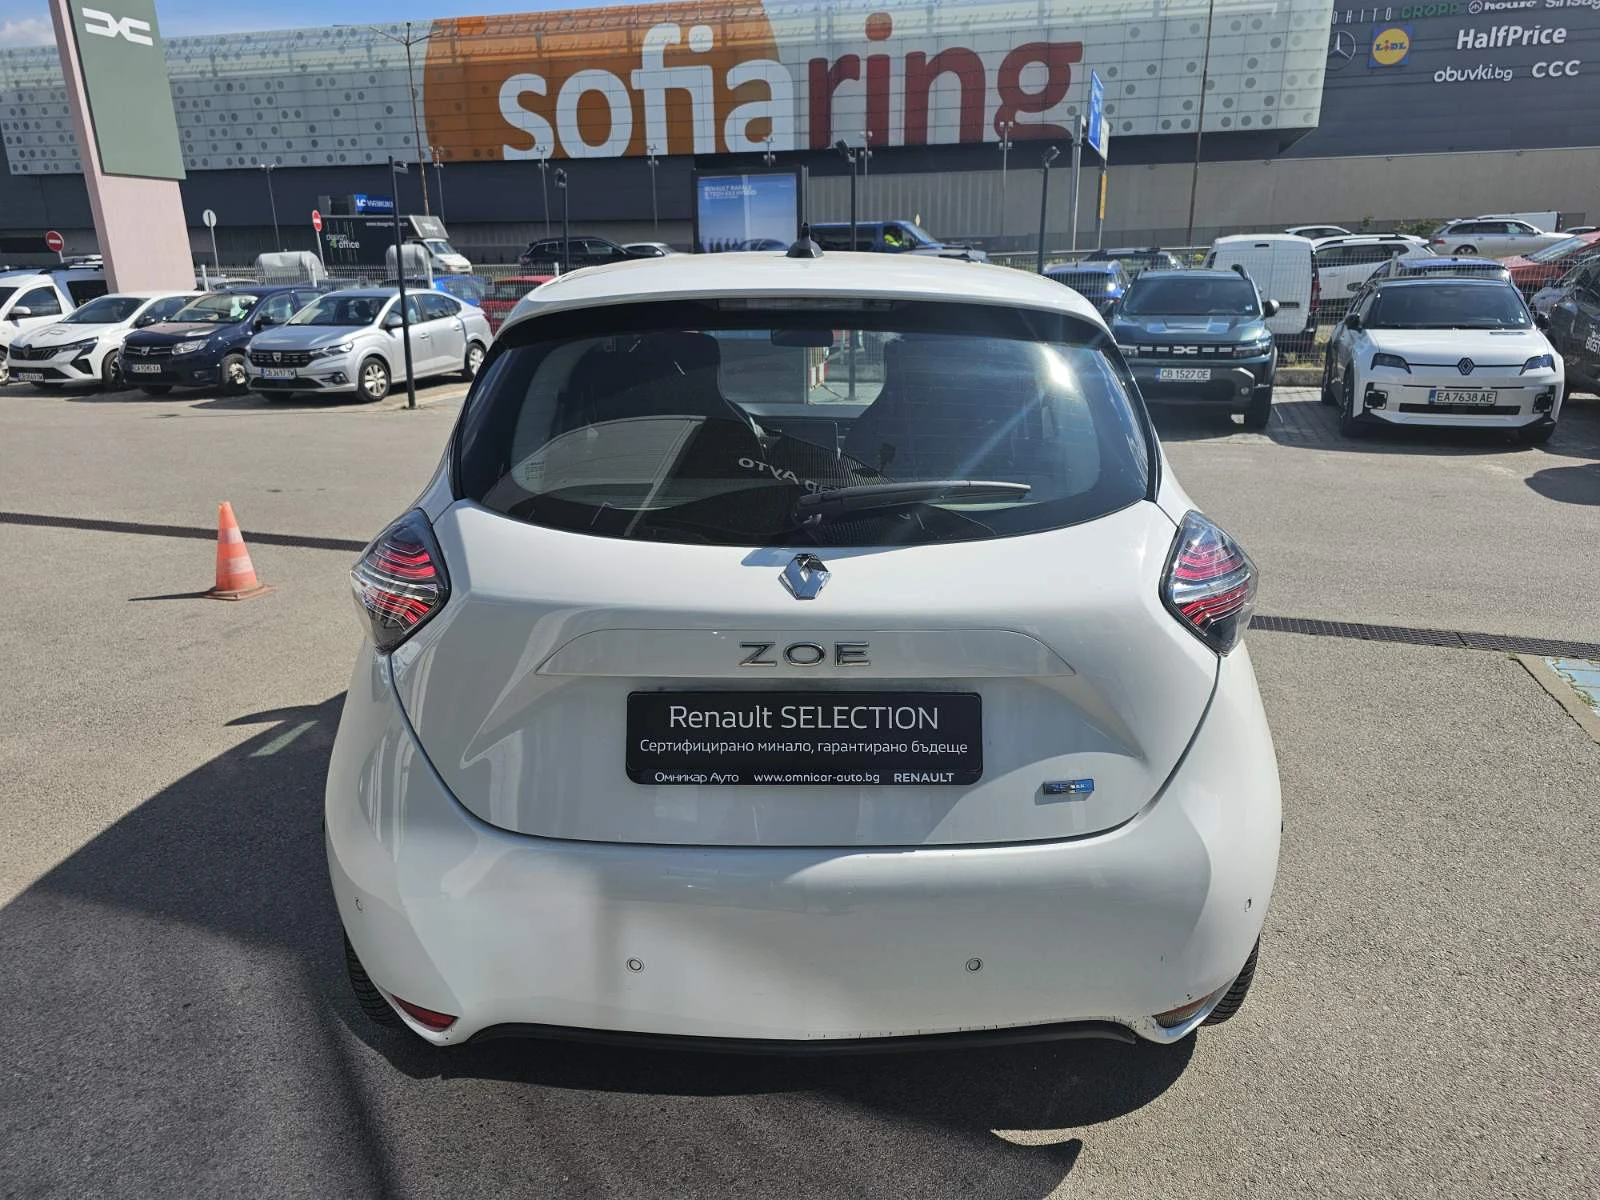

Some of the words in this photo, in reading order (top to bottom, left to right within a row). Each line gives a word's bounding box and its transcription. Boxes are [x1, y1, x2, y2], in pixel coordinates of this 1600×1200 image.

[1457, 25, 1567, 50] HalfPrice
[1434, 63, 1513, 82] obuvki.bg
[1532, 60, 1580, 78] CCC
[338, 240, 360, 248] office
[1437, 392, 1450, 402] EA
[1451, 392, 1478, 402] 7638
[1479, 393, 1493, 403] AE
[740, 642, 871, 667] ZOE
[669, 705, 772, 728] Renault
[781, 706, 938, 729] SELECTION
[640, 739, 754, 755] Сертифицирано
[758, 742, 814, 754] минало,
[817, 742, 907, 755] гарантирано
[911, 741, 968, 755] бъдеще
[654, 772, 707, 783] Омникар
[710, 772, 739, 784] Ауто
[753, 772, 880, 784] www.omnicar-auto.bg
[894, 773, 954, 783] RENAULT
